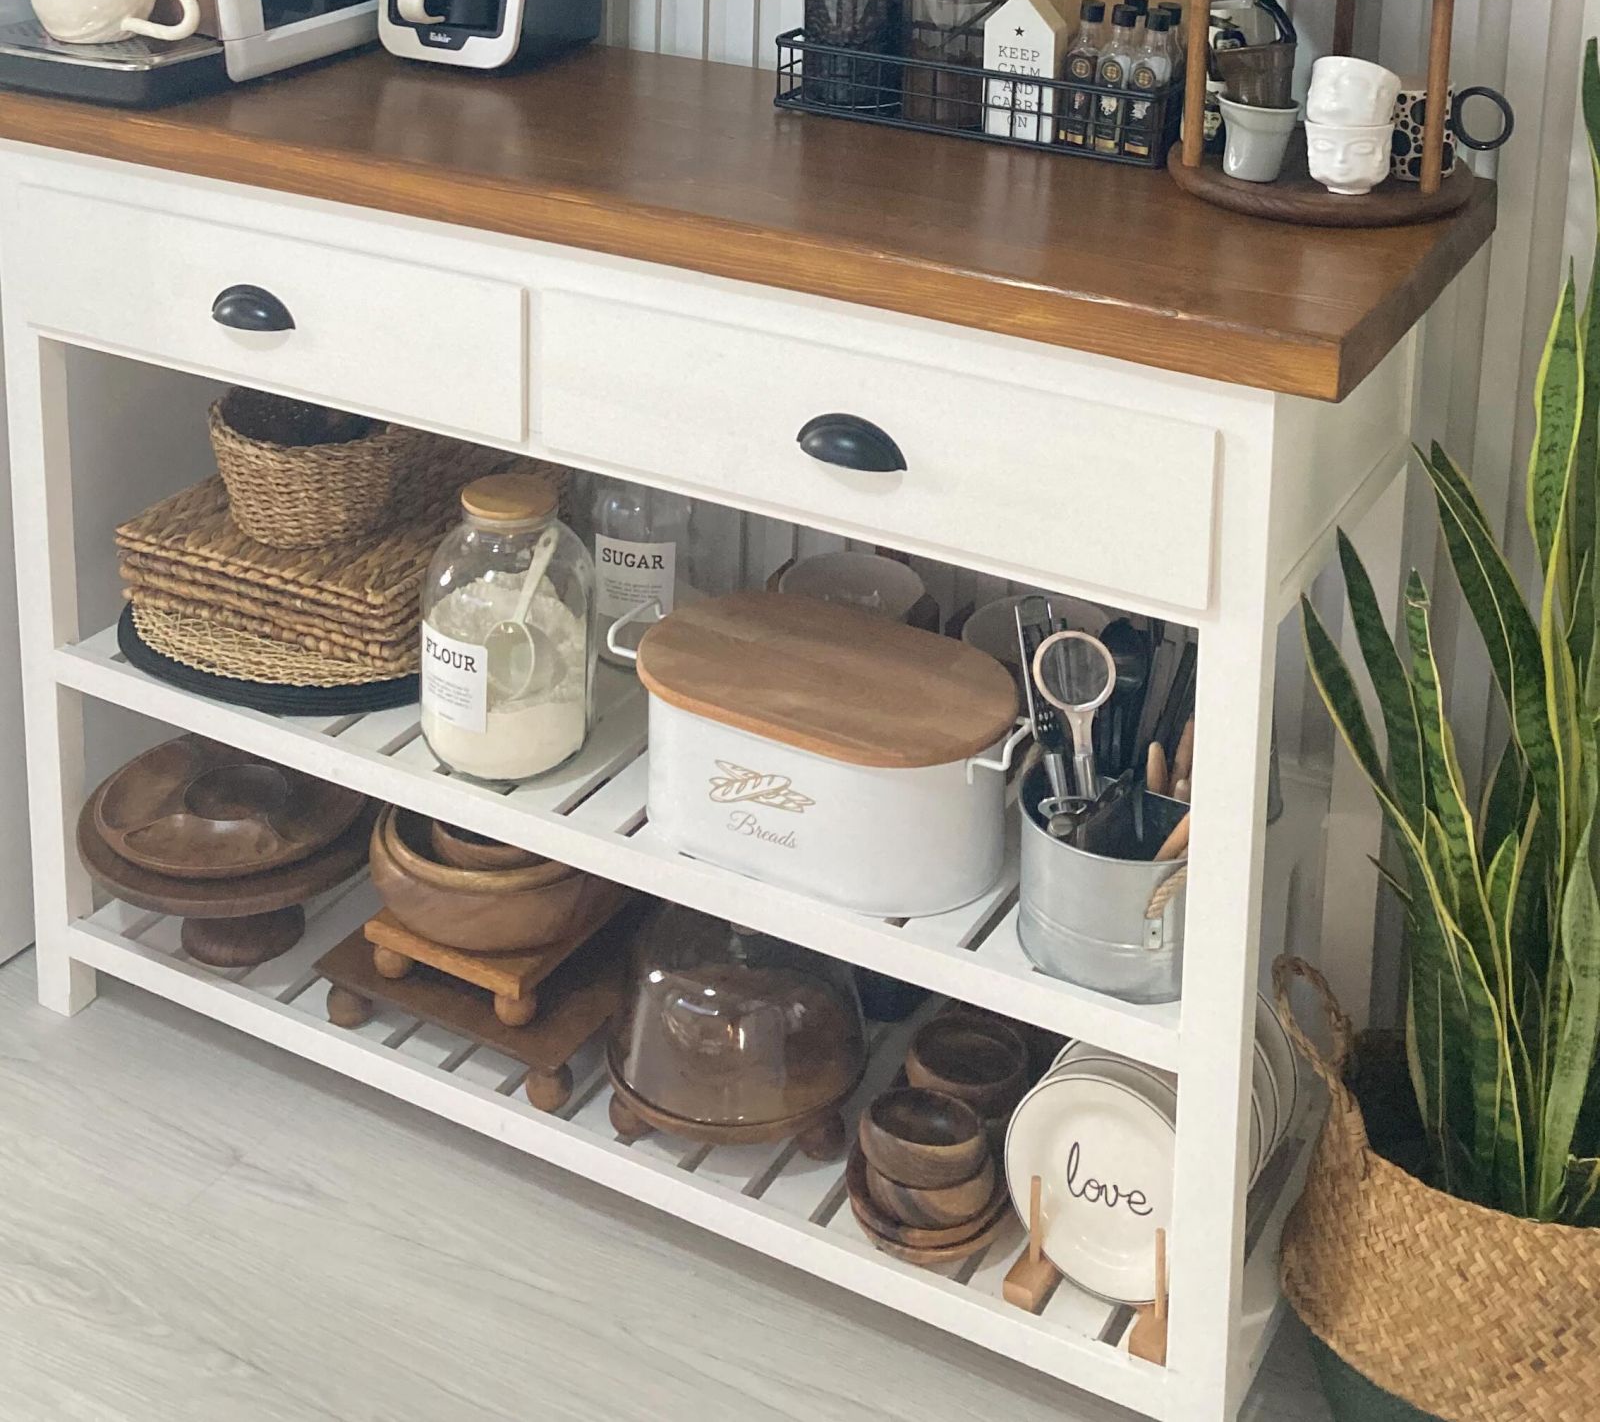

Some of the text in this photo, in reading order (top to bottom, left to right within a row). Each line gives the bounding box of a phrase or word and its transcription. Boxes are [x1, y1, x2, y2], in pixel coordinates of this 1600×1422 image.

[998, 45, 1041, 62] KEEP
[602, 547, 665, 570] SUGAR
[426, 637, 478, 673] FLOUR
[727, 810, 796, 849] Breads
[1066, 1141, 1154, 1216] love
